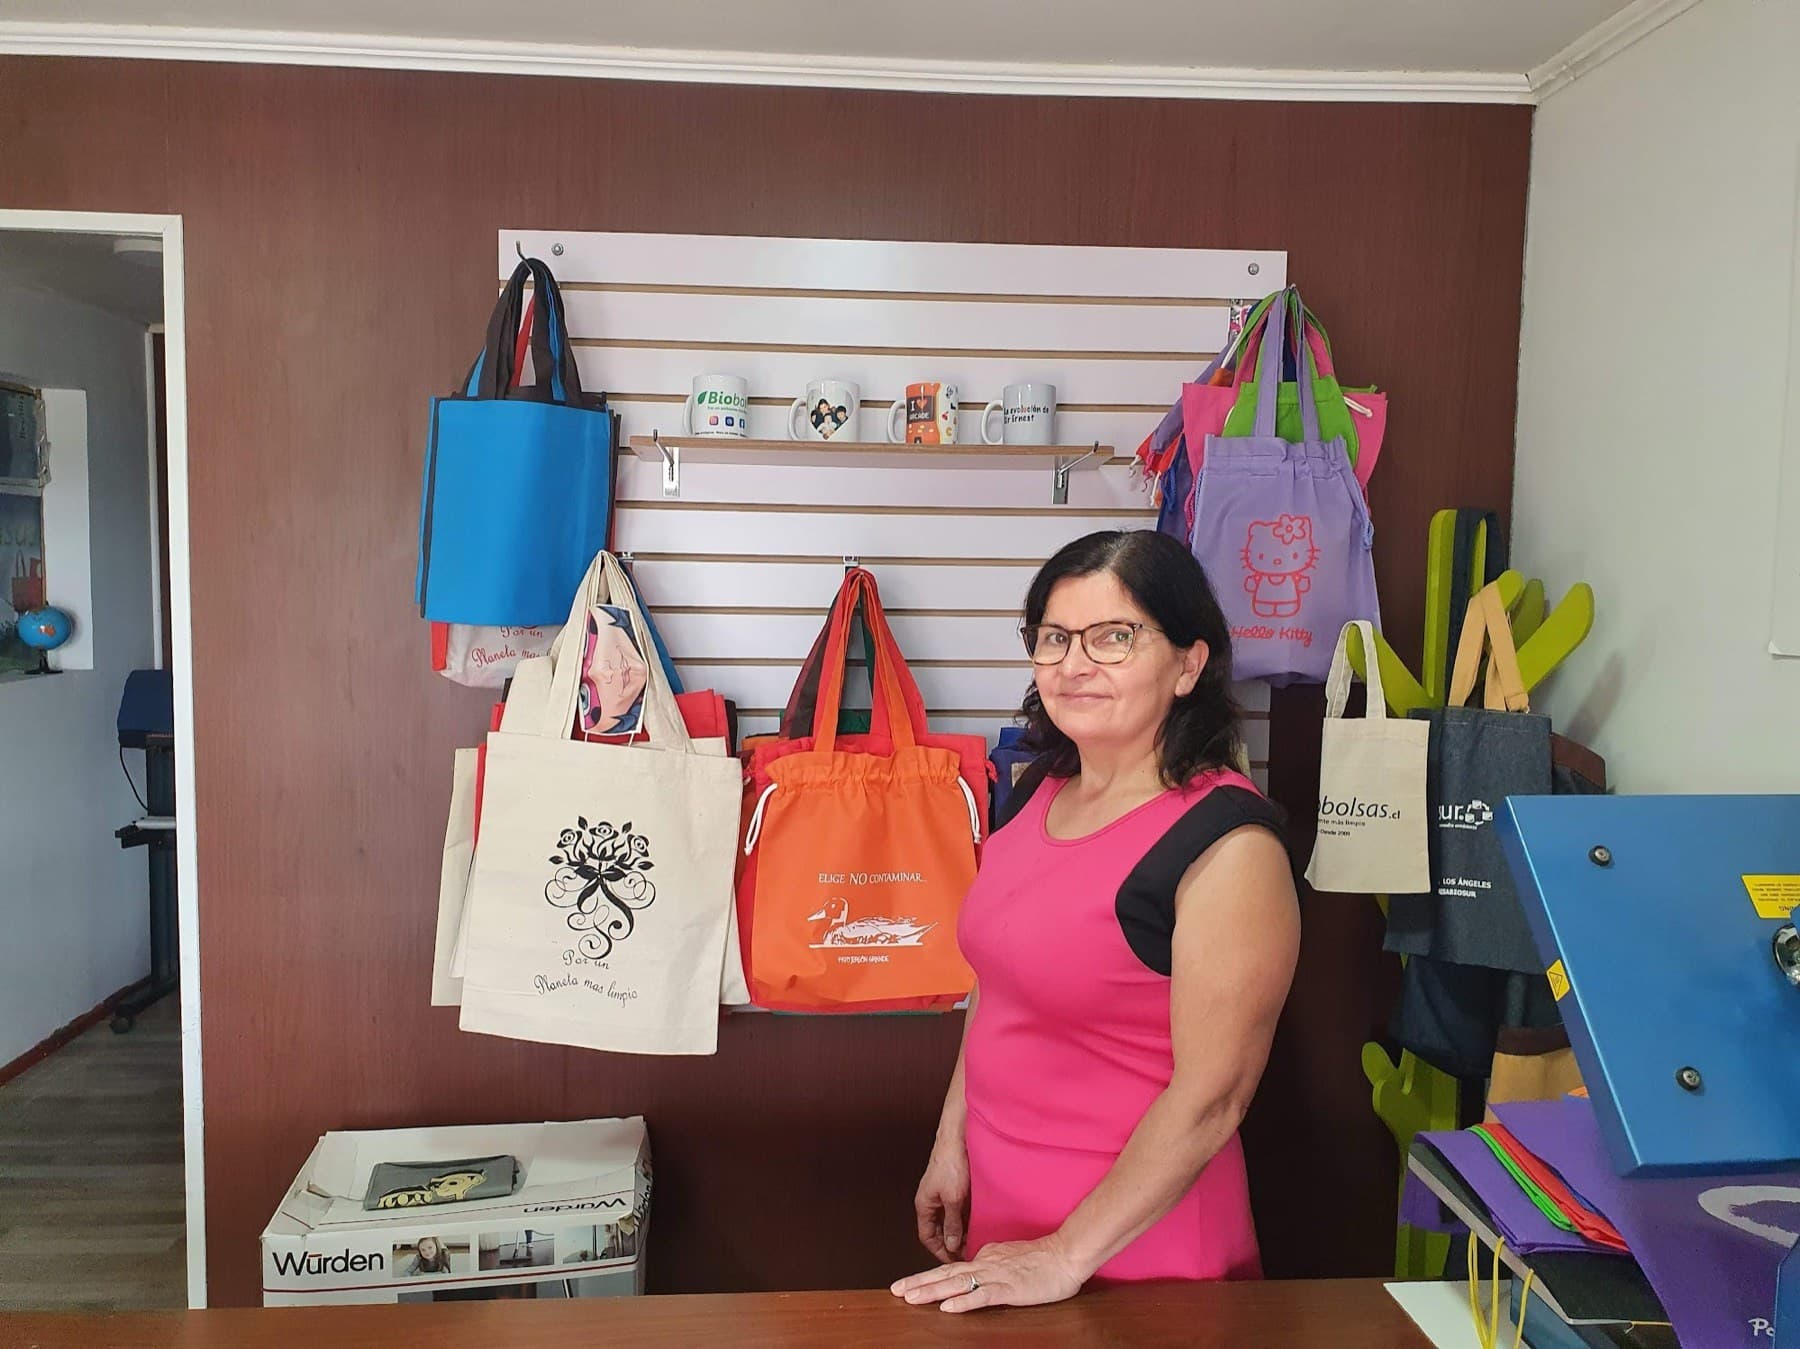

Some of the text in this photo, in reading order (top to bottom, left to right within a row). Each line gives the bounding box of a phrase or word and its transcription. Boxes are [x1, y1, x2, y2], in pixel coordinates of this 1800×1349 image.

[1231, 625, 1313, 648] Hello Kitty
[471, 644, 516, 668] Planeta
[1319, 795, 1401, 820] bolsas.cl
[818, 873, 846, 884] ELIGE
[849, 872, 868, 886] NO
[1442, 877, 1457, 886] LOS
[562, 949, 610, 970] Por un
[533, 974, 638, 1008] Planeta mas limpio
